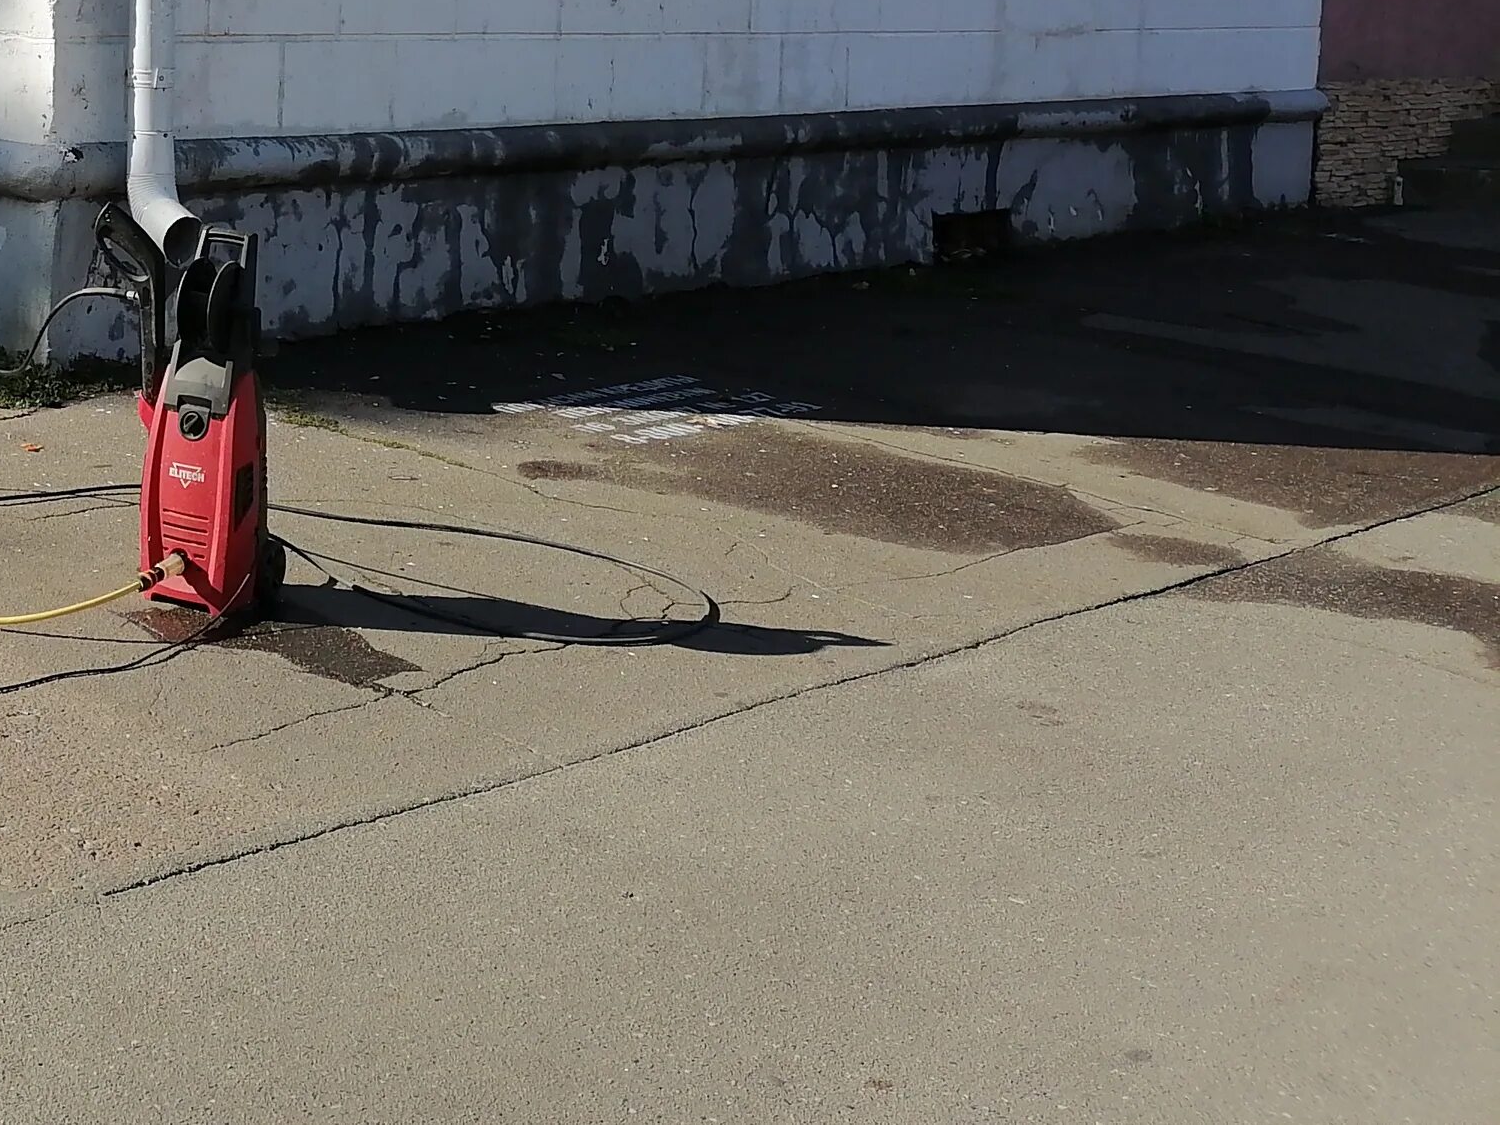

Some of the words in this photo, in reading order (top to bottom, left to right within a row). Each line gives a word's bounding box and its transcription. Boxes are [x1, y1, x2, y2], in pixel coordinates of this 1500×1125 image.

[729, 391, 780, 404] 127
[610, 400, 826, 445] 8-800-00-77-91
[169, 467, 205, 483] ELITECH
